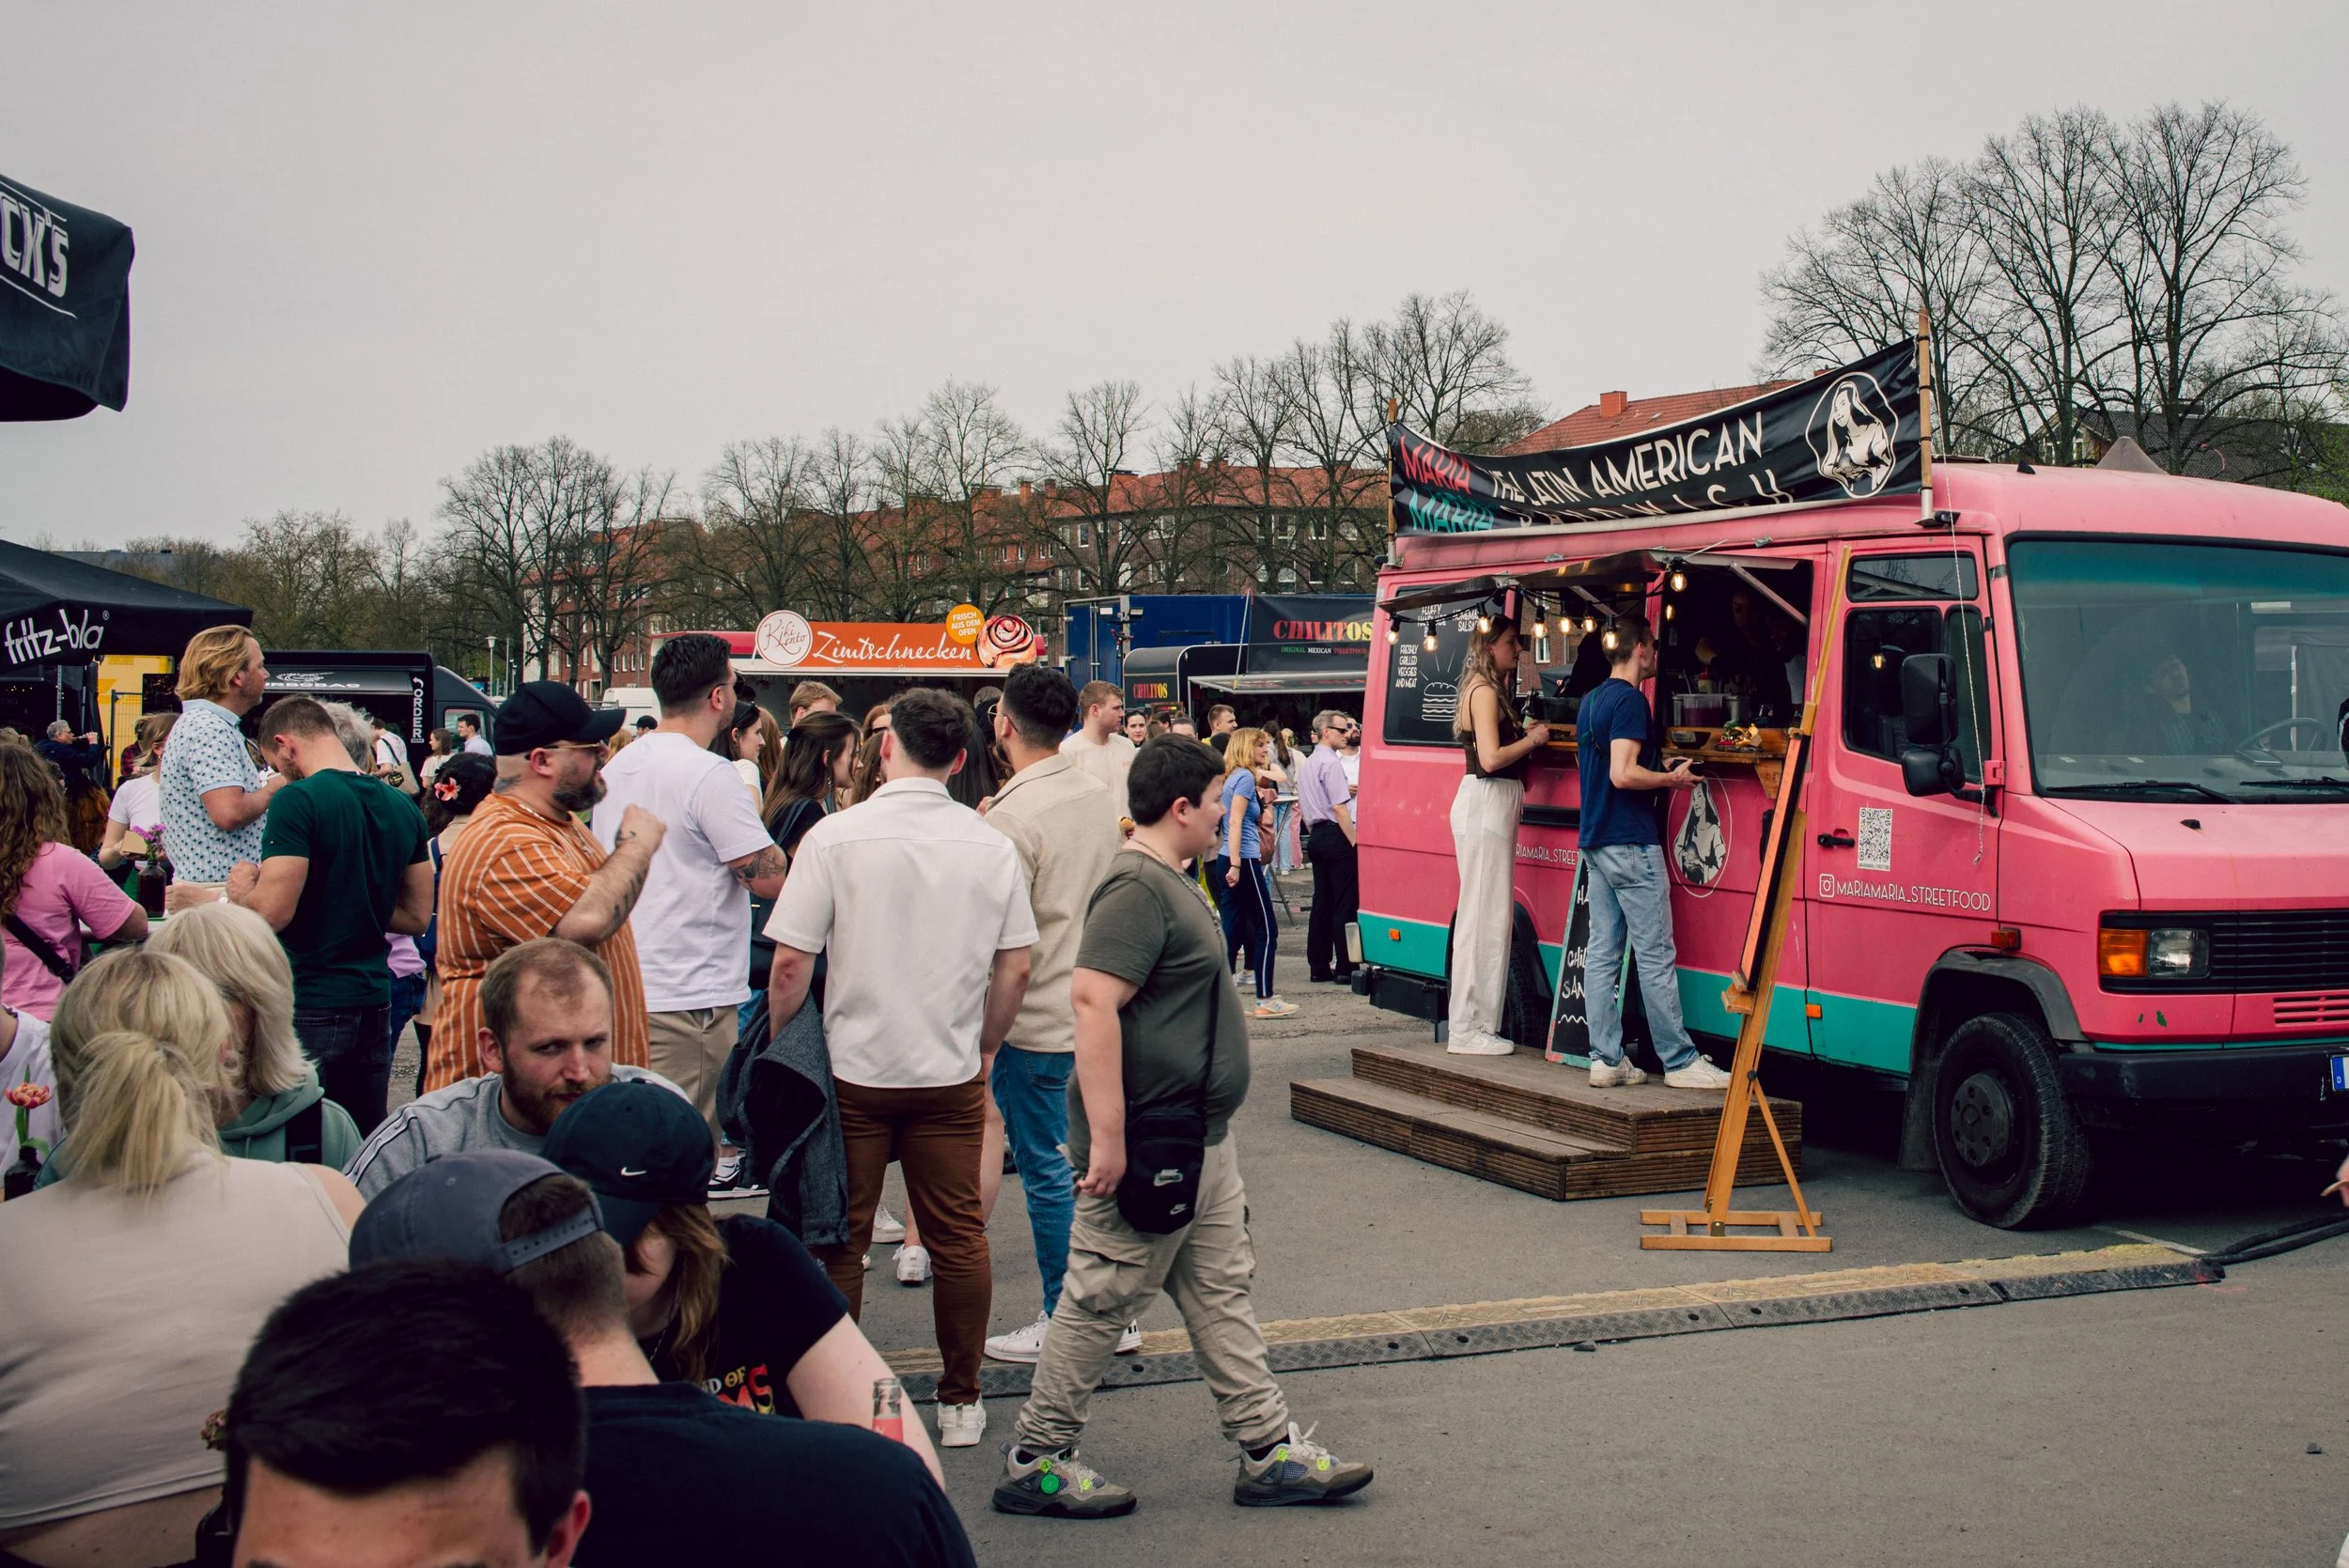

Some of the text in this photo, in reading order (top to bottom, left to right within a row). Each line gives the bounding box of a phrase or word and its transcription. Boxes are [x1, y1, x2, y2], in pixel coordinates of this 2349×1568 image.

[1400, 435, 1471, 495] MARIA
[1508, 467, 1593, 505] LATIN
[1590, 411, 1763, 499] AMERICAN
[1409, 485, 1495, 534] MARIA
[951, 619, 981, 630] AUS DEM
[952, 612, 977, 622] FRISCH
[957, 627, 977, 637] OFEN
[1273, 620, 1373, 642] CHILITOS
[812, 629, 972, 664] Zimtschnecken
[1281, 645, 1306, 654] ORIGINAL
[1132, 683, 1168, 699] CHILITOS
[412, 688, 425, 738] ORDER
[1836, 879, 1992, 911] MARIAMARIA_STREETFOOD
[724, 1365, 746, 1388] OF
